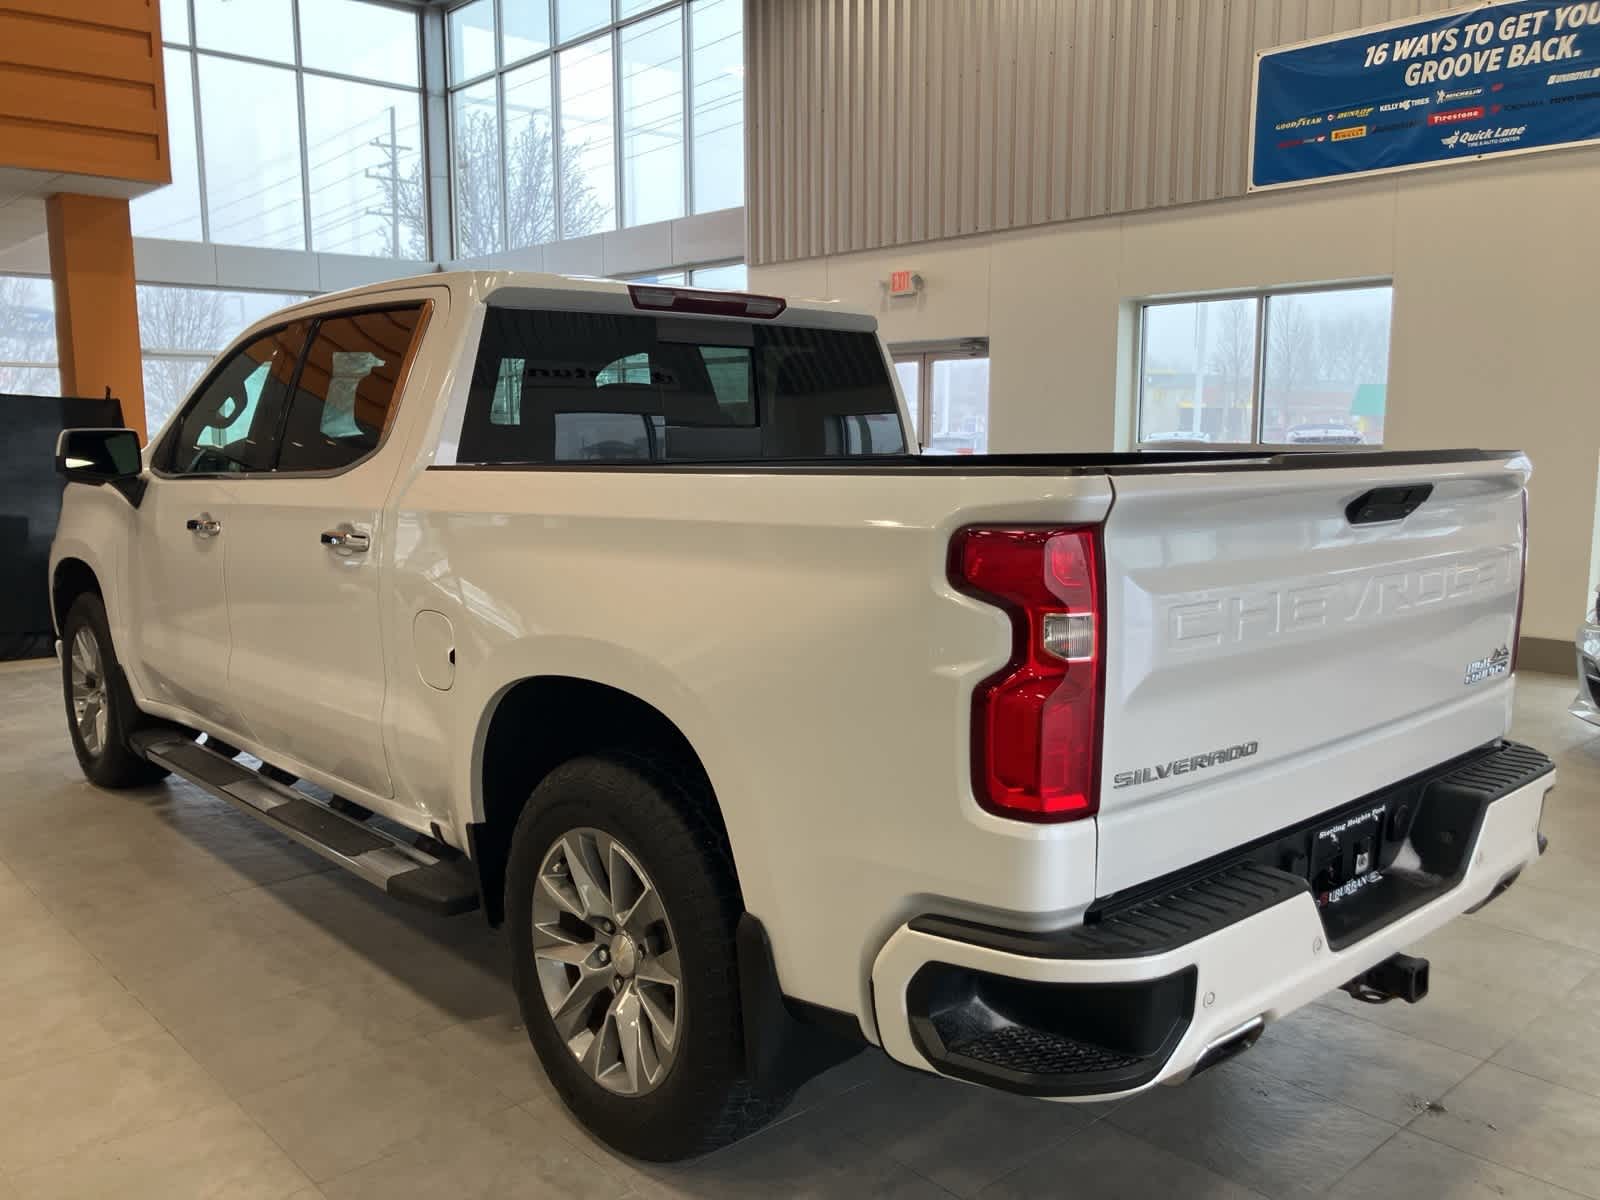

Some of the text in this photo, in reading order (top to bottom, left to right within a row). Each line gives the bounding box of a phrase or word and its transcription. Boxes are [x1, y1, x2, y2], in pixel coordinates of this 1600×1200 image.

[1364, 43, 1390, 68] 16
[1393, 28, 1459, 62] WAYS
[1464, 21, 1495, 49] TO
[1499, 10, 1549, 41] GET
[1405, 33, 1583, 87] GROOVE BACK.
[1275, 116, 1322, 131] GOODYEAR
[1380, 101, 1399, 112] KELLY
[1445, 88, 1483, 100] MICHELIN
[1434, 109, 1480, 124] Firestone
[1460, 126, 1526, 144] Quick Lane
[1113, 740, 1259, 790] SILVERADO
[1319, 823, 1346, 839] Sterling
[1346, 811, 1372, 828] Heights
